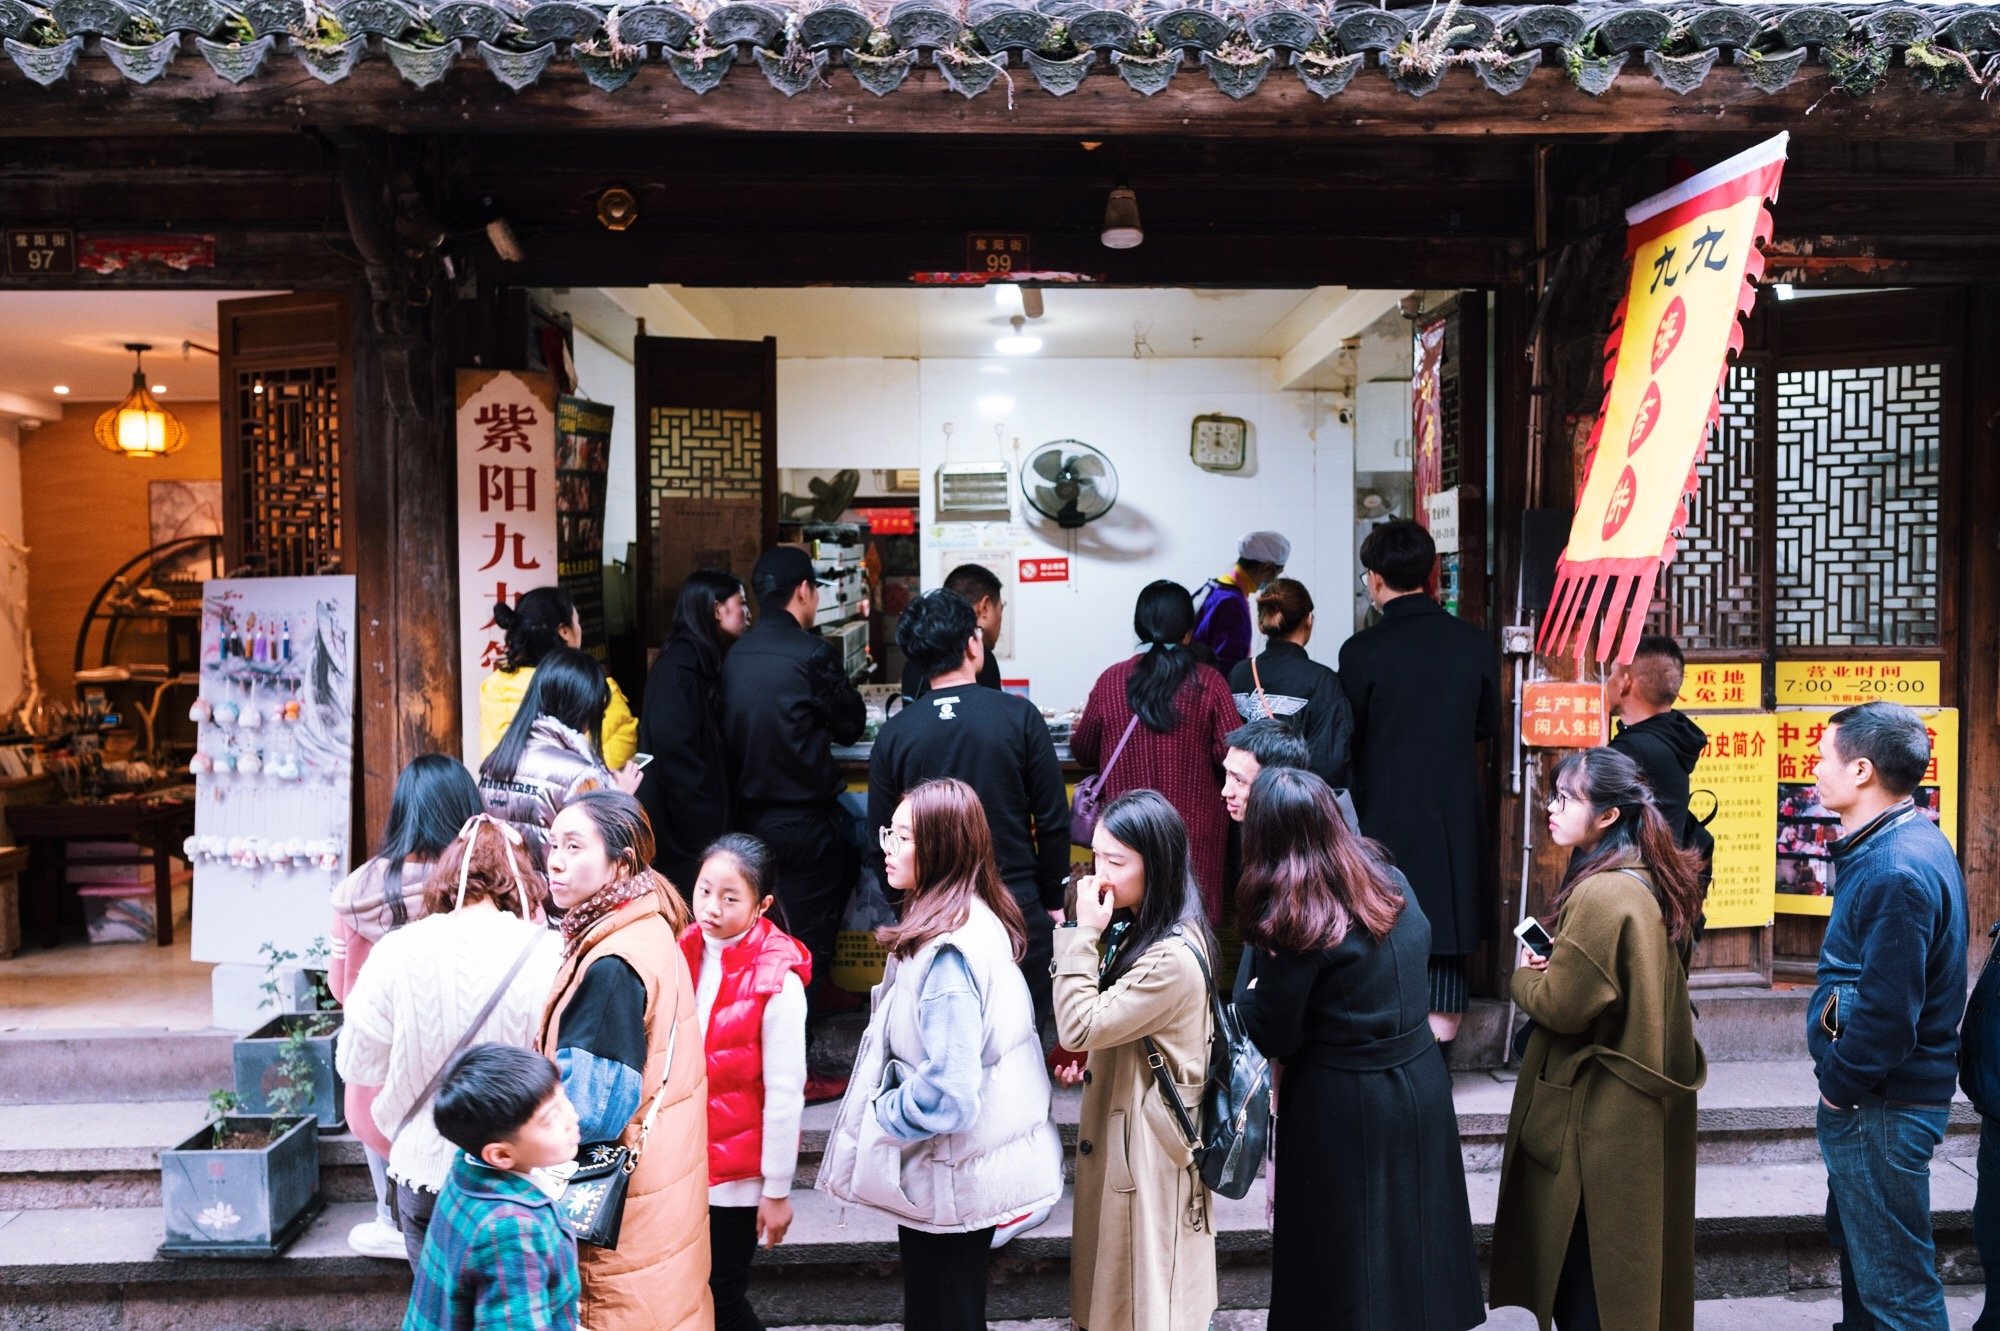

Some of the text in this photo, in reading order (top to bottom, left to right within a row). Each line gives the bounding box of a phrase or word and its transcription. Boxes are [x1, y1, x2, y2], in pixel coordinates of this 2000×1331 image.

[28, 250, 54, 269] 97
[986, 254, 1011, 272] 99
[1685, 670, 1745, 684] 重地
[1808, 666, 1900, 677] 营业时间
[1784, 680, 1832, 692] 7:00
[1535, 696, 1600, 713] 生产重地
[1534, 719, 1600, 736] 闲人免进
